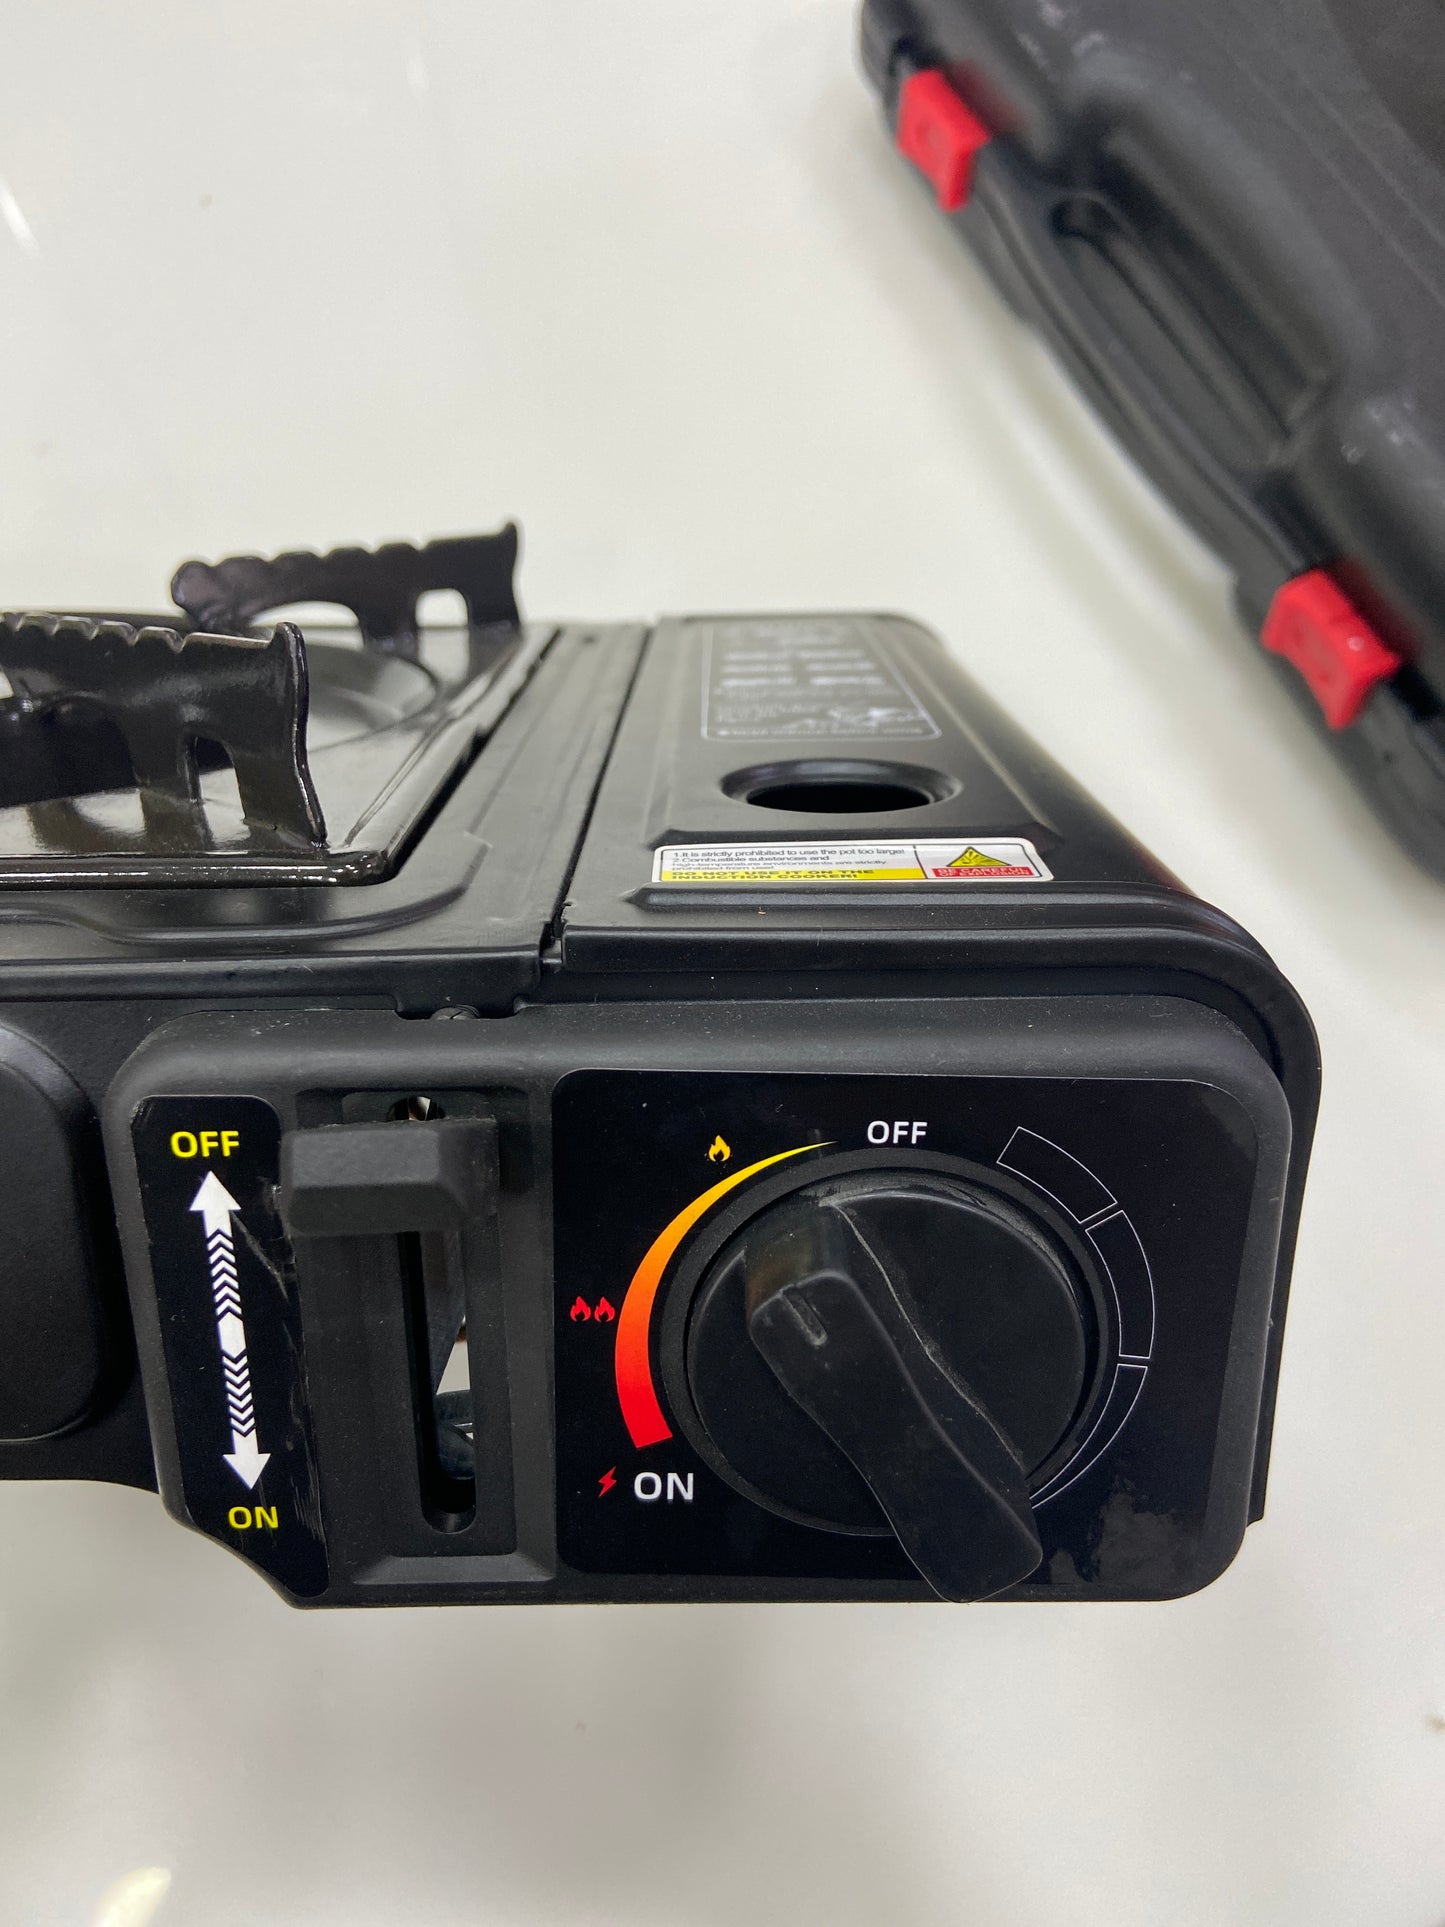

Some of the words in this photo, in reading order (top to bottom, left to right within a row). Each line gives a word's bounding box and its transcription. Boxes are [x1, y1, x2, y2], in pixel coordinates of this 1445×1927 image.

[170, 1131, 239, 1158] OFF
[866, 1120, 928, 1144] OFF
[634, 1472, 694, 1502] ON
[228, 1506, 278, 1530] ON
